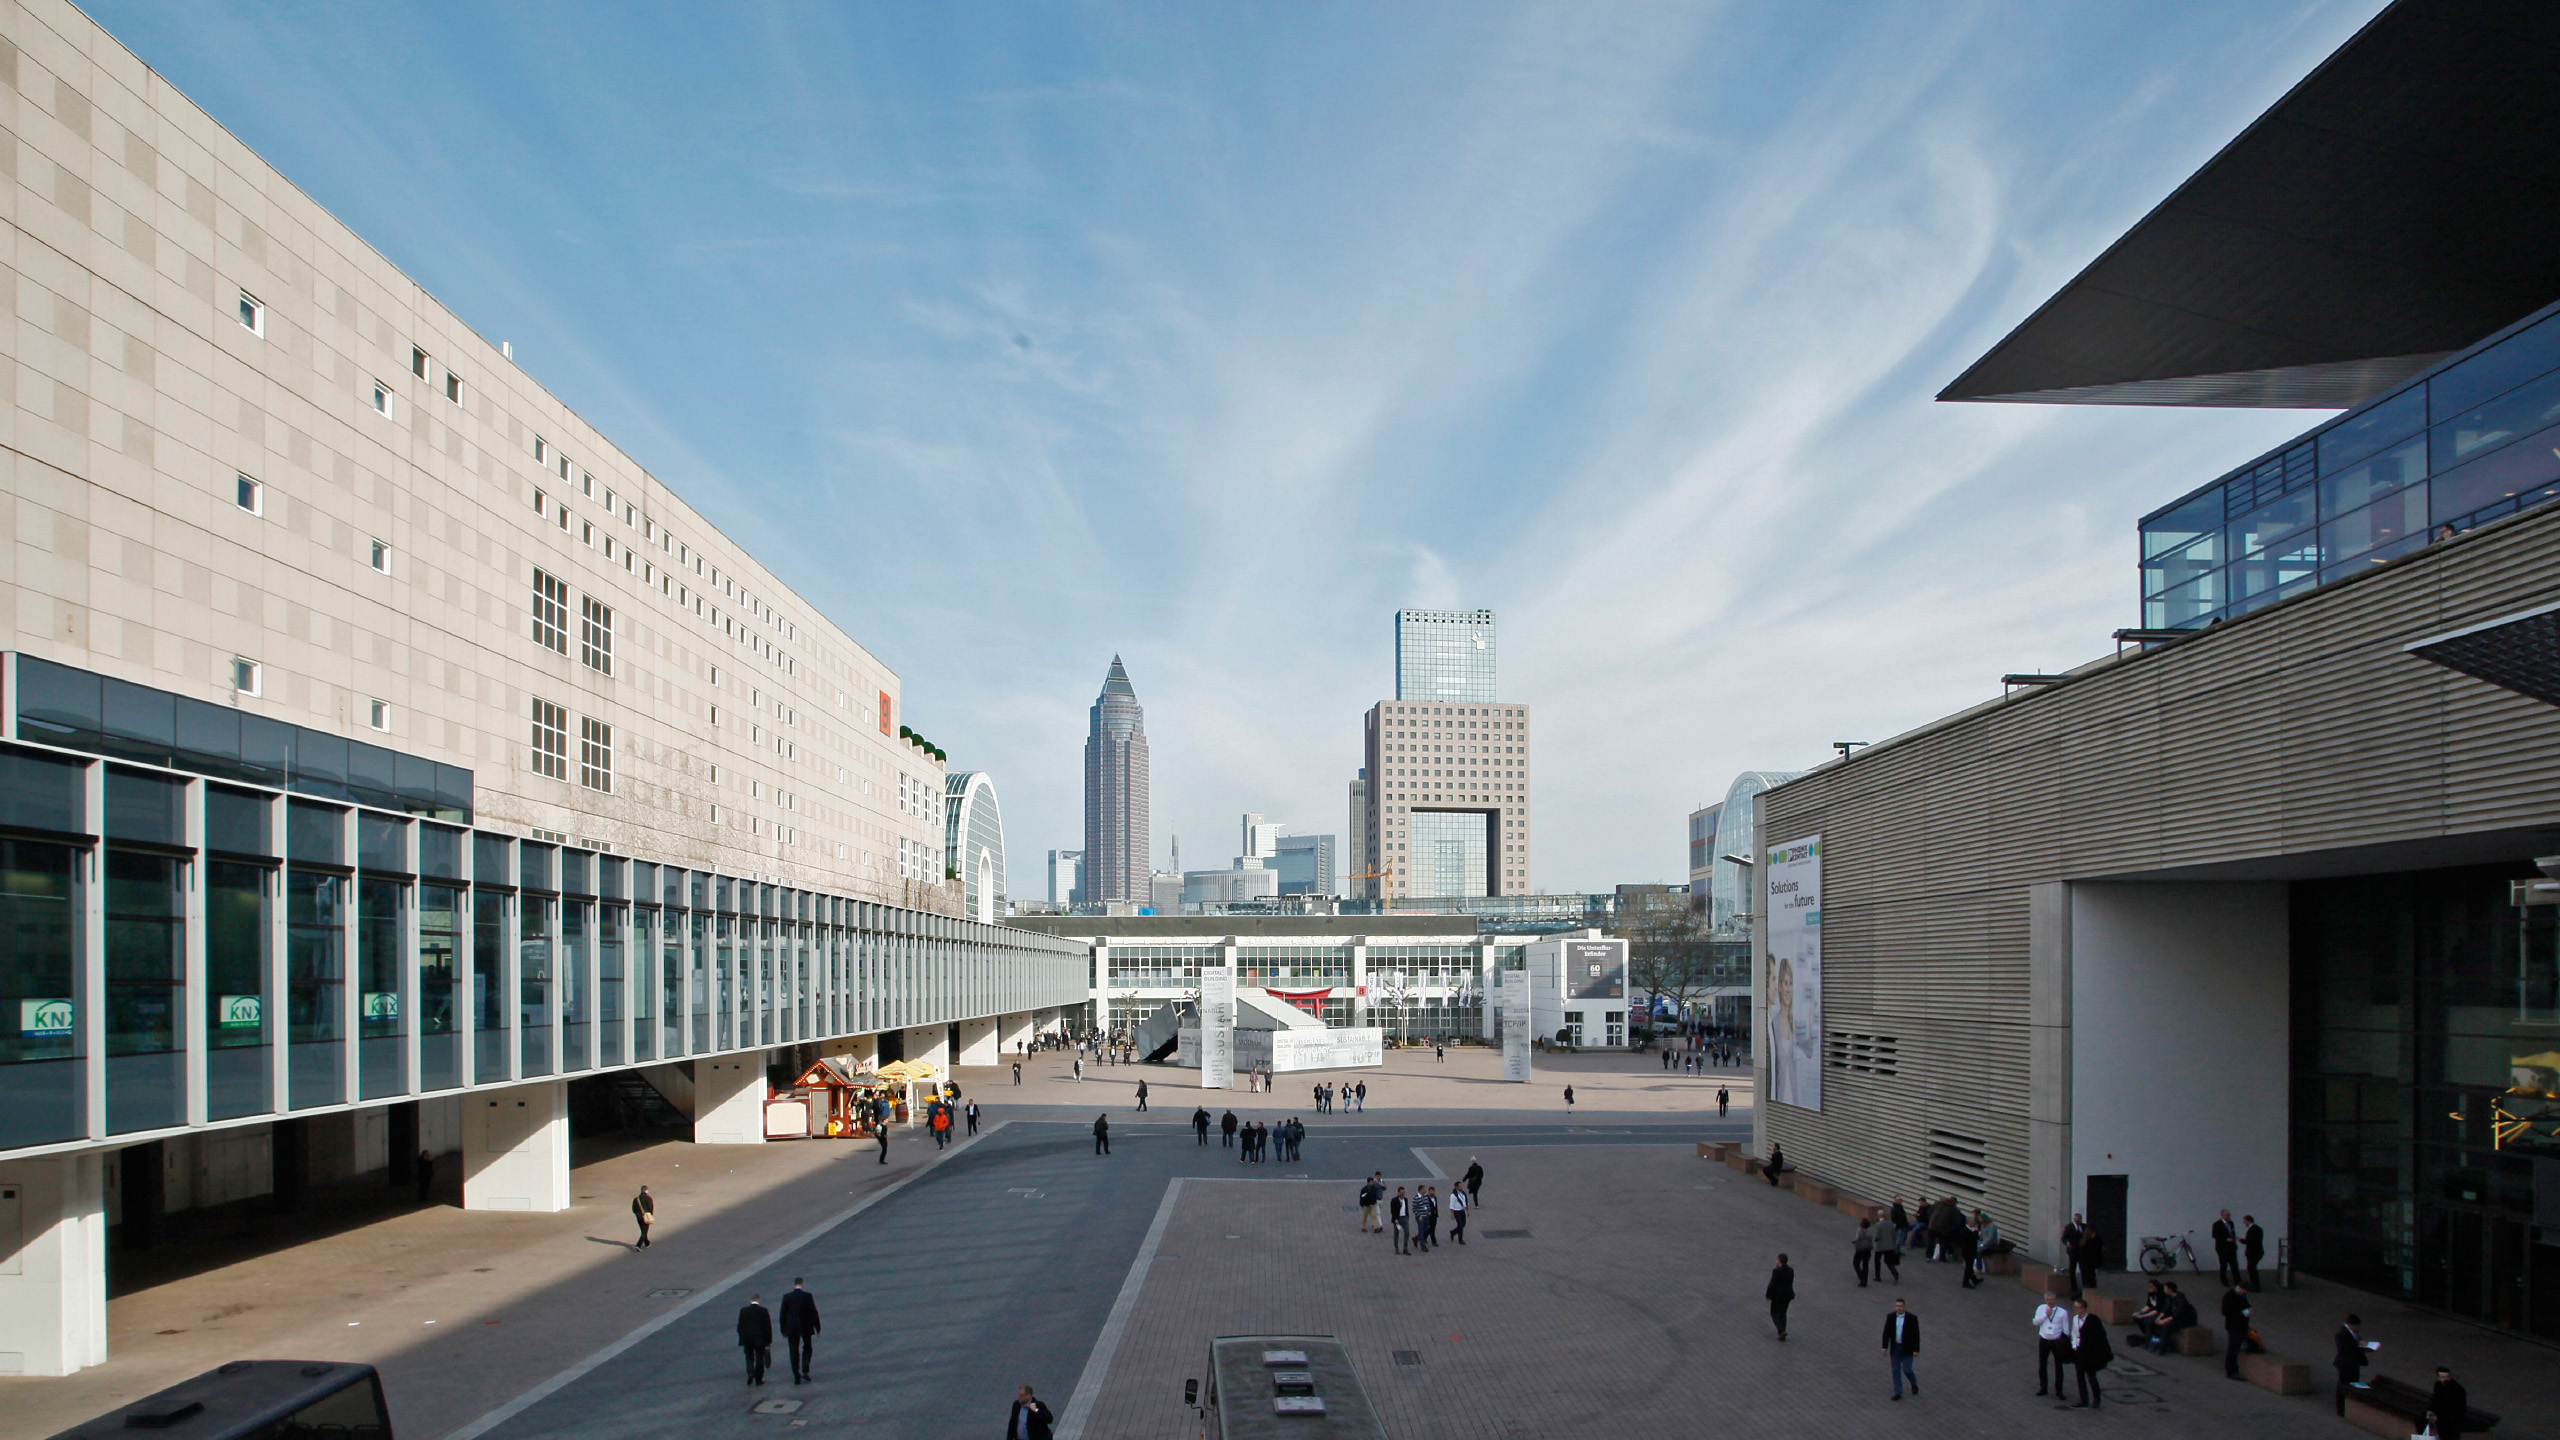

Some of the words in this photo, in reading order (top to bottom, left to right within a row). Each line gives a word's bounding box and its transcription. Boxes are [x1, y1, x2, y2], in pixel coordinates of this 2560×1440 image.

[1771, 880, 1799, 895] Solutions
[1794, 894, 1815, 908] future
[1359, 987, 1364, 995] 8
[1504, 1020, 1526, 1028] TCP/IP
